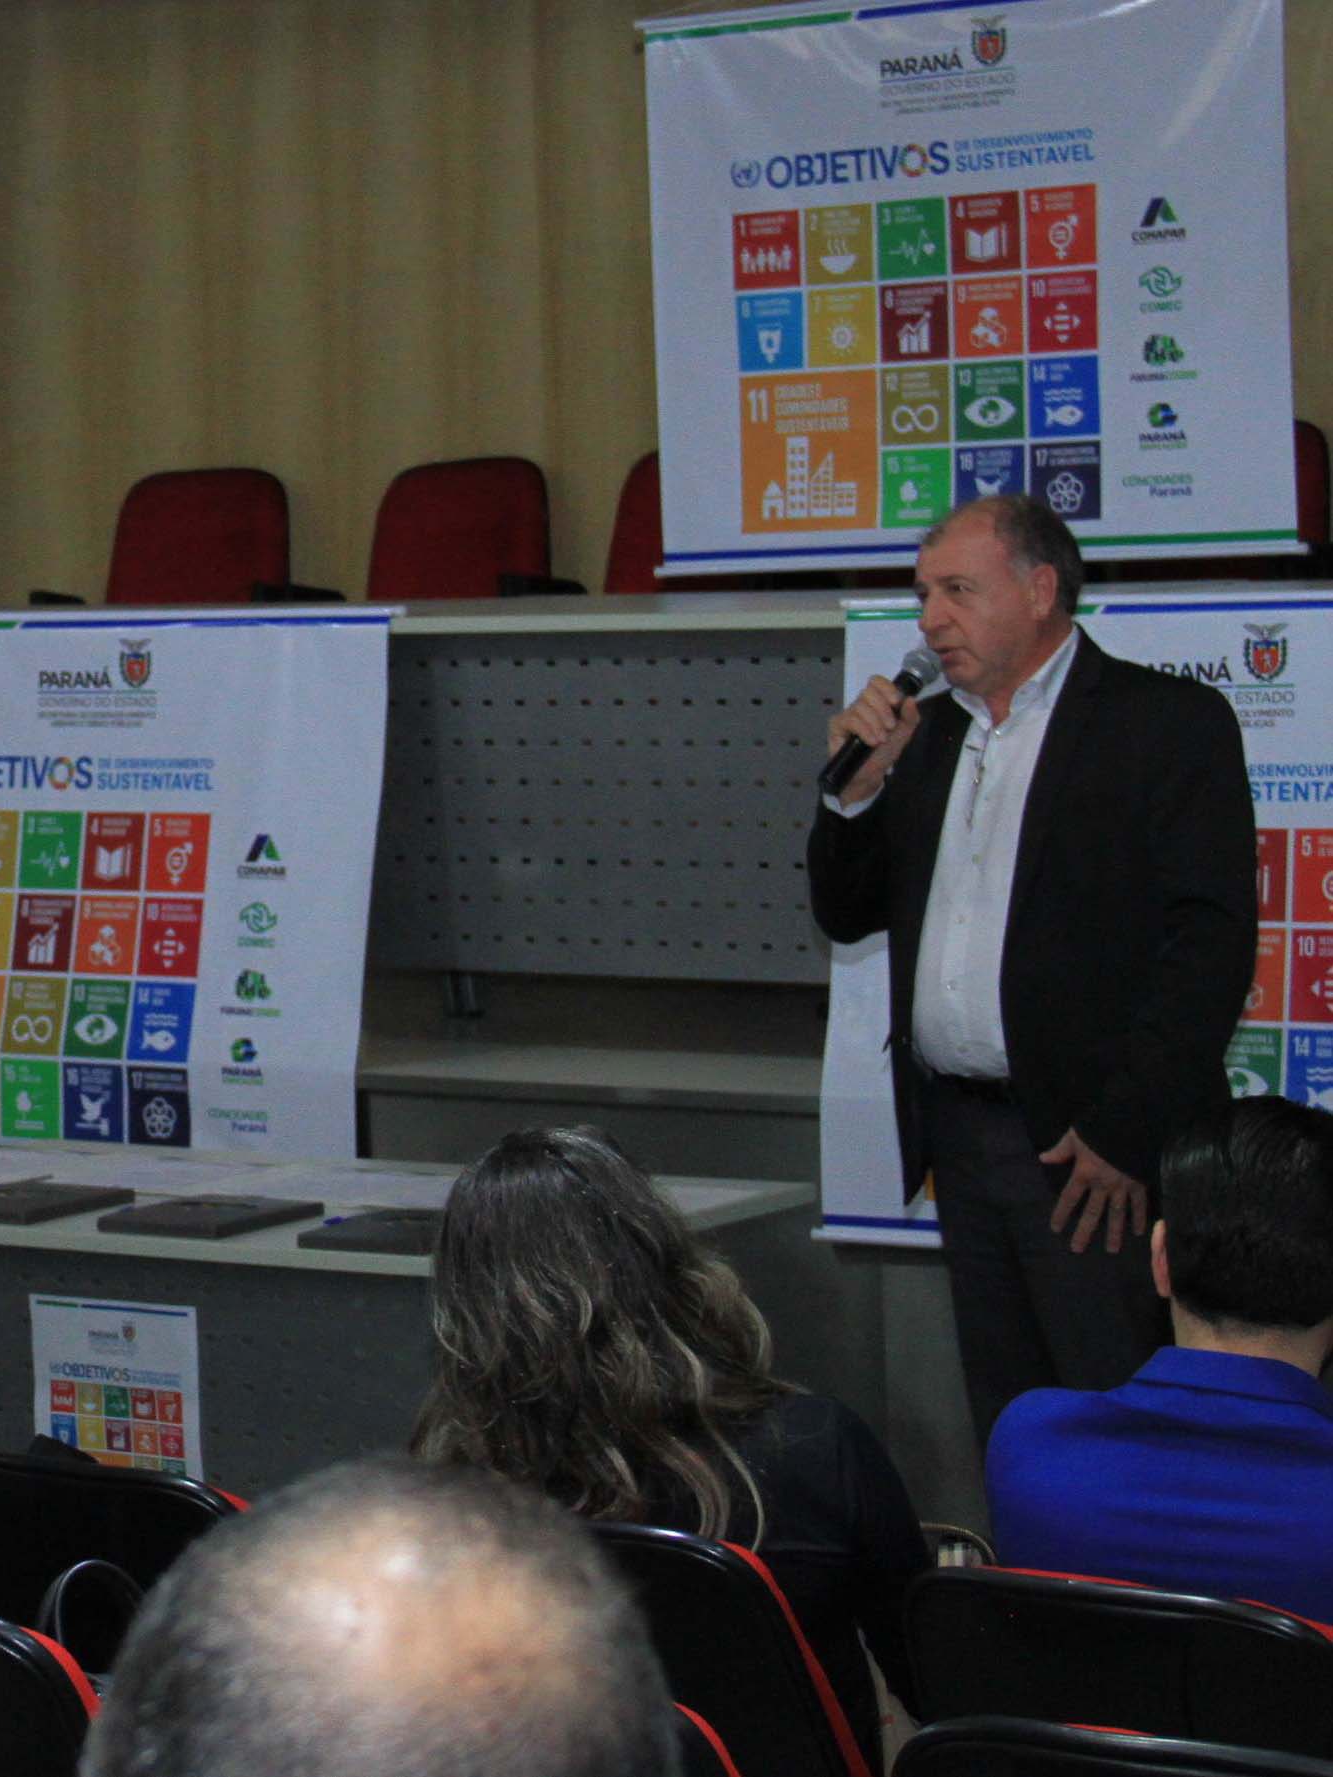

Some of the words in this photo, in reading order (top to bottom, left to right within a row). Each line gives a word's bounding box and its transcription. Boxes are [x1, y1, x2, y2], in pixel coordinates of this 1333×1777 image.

[880, 47, 964, 78] PARANÁ
[975, 128, 1093, 149] DESENVOLVIMENTO
[767, 141, 950, 189] OBJETIVOS
[956, 144, 1095, 173] SUSTENTAVEL
[1131, 228, 1187, 243] COHAPAR
[747, 388, 770, 424] 11
[39, 666, 113, 689] PARANÁ
[1235, 691, 1295, 705] ESTADO
[1235, 708, 1295, 718] OLVIMENTO
[98, 772, 213, 792] SUSTENTAVEL
[1301, 835, 1312, 857] 5
[1297, 936, 1315, 957] 10
[1294, 1035, 1310, 1057] 14
